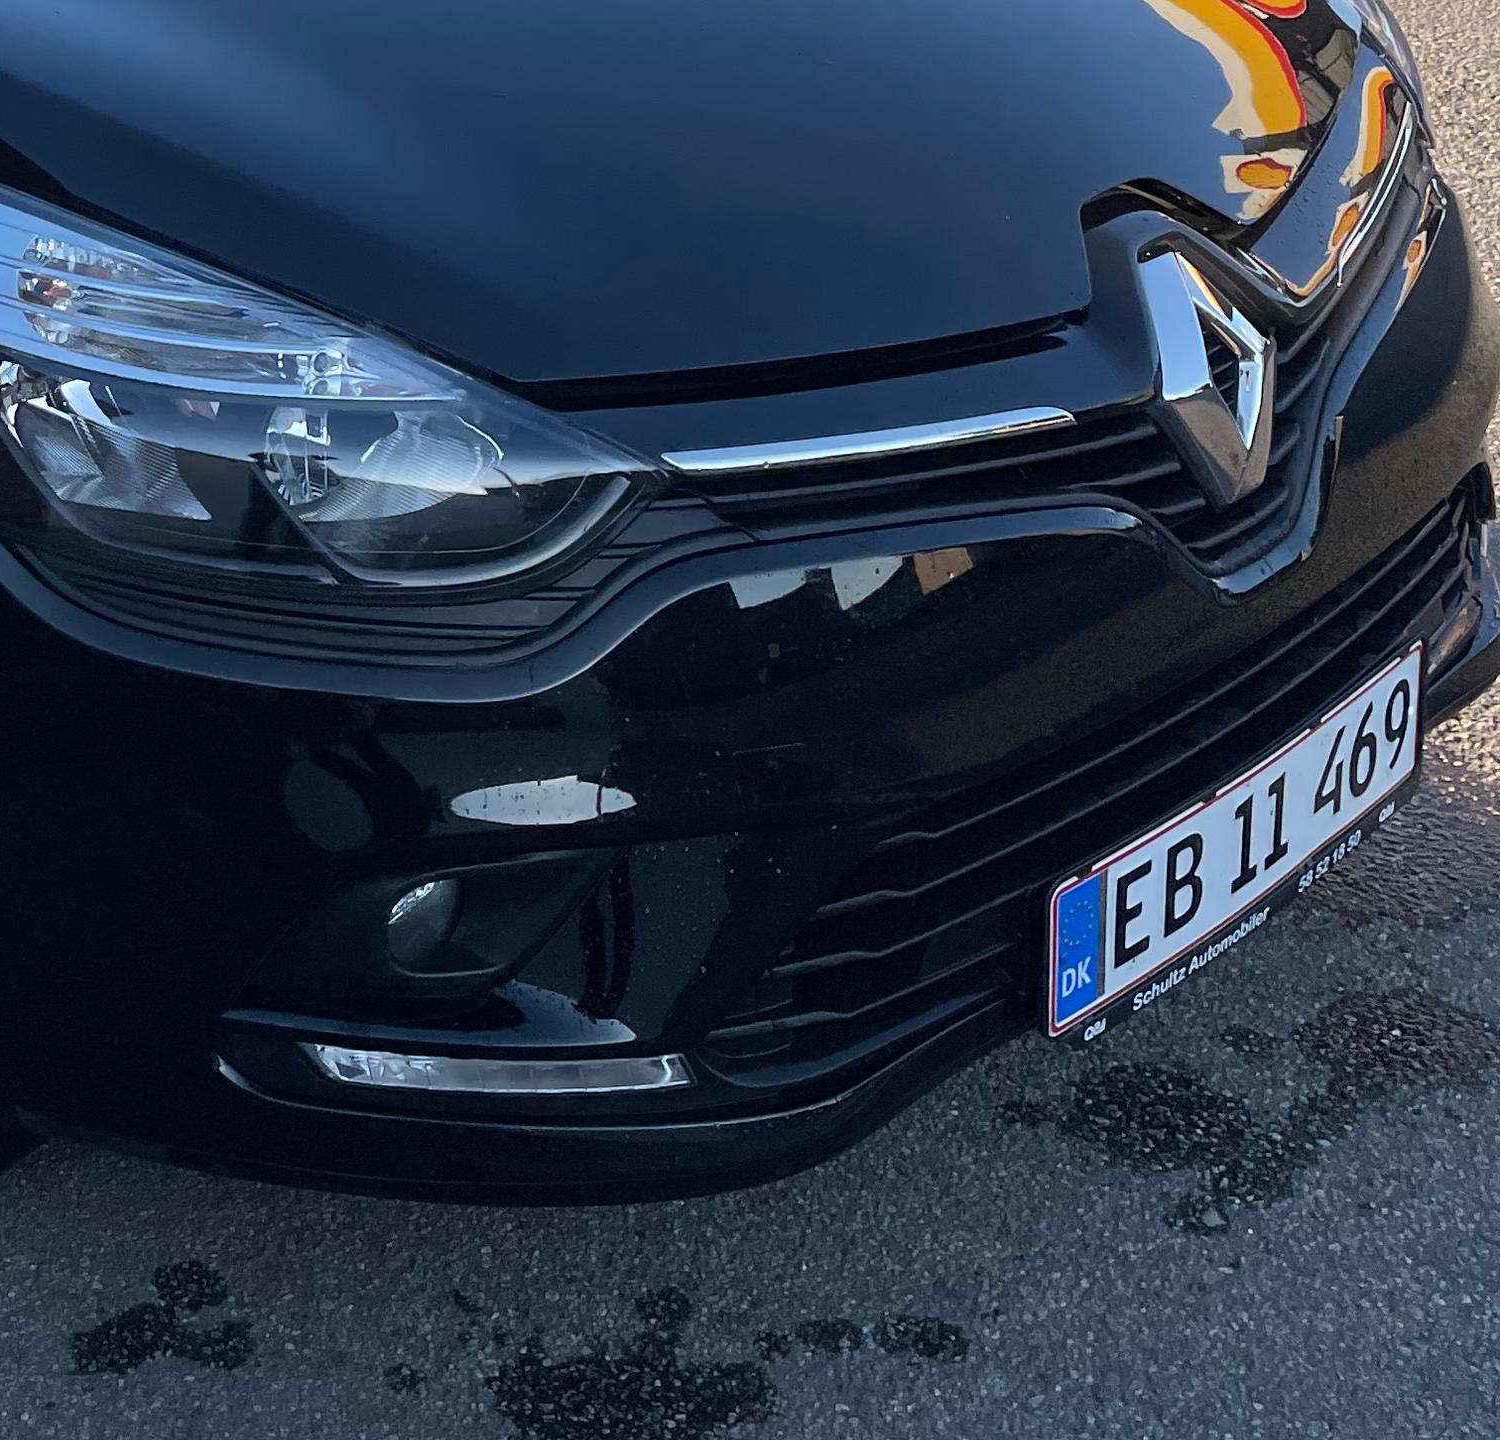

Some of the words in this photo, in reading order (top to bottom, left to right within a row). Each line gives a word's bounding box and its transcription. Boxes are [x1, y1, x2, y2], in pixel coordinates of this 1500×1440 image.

[1113, 832, 1204, 969] EB
[1230, 772, 1289, 894] 11
[1313, 679, 1411, 815] 469
[1062, 956, 1091, 998] DK
[1133, 965, 1186, 1011] Schultz
[1188, 907, 1271, 976] Automobiler
